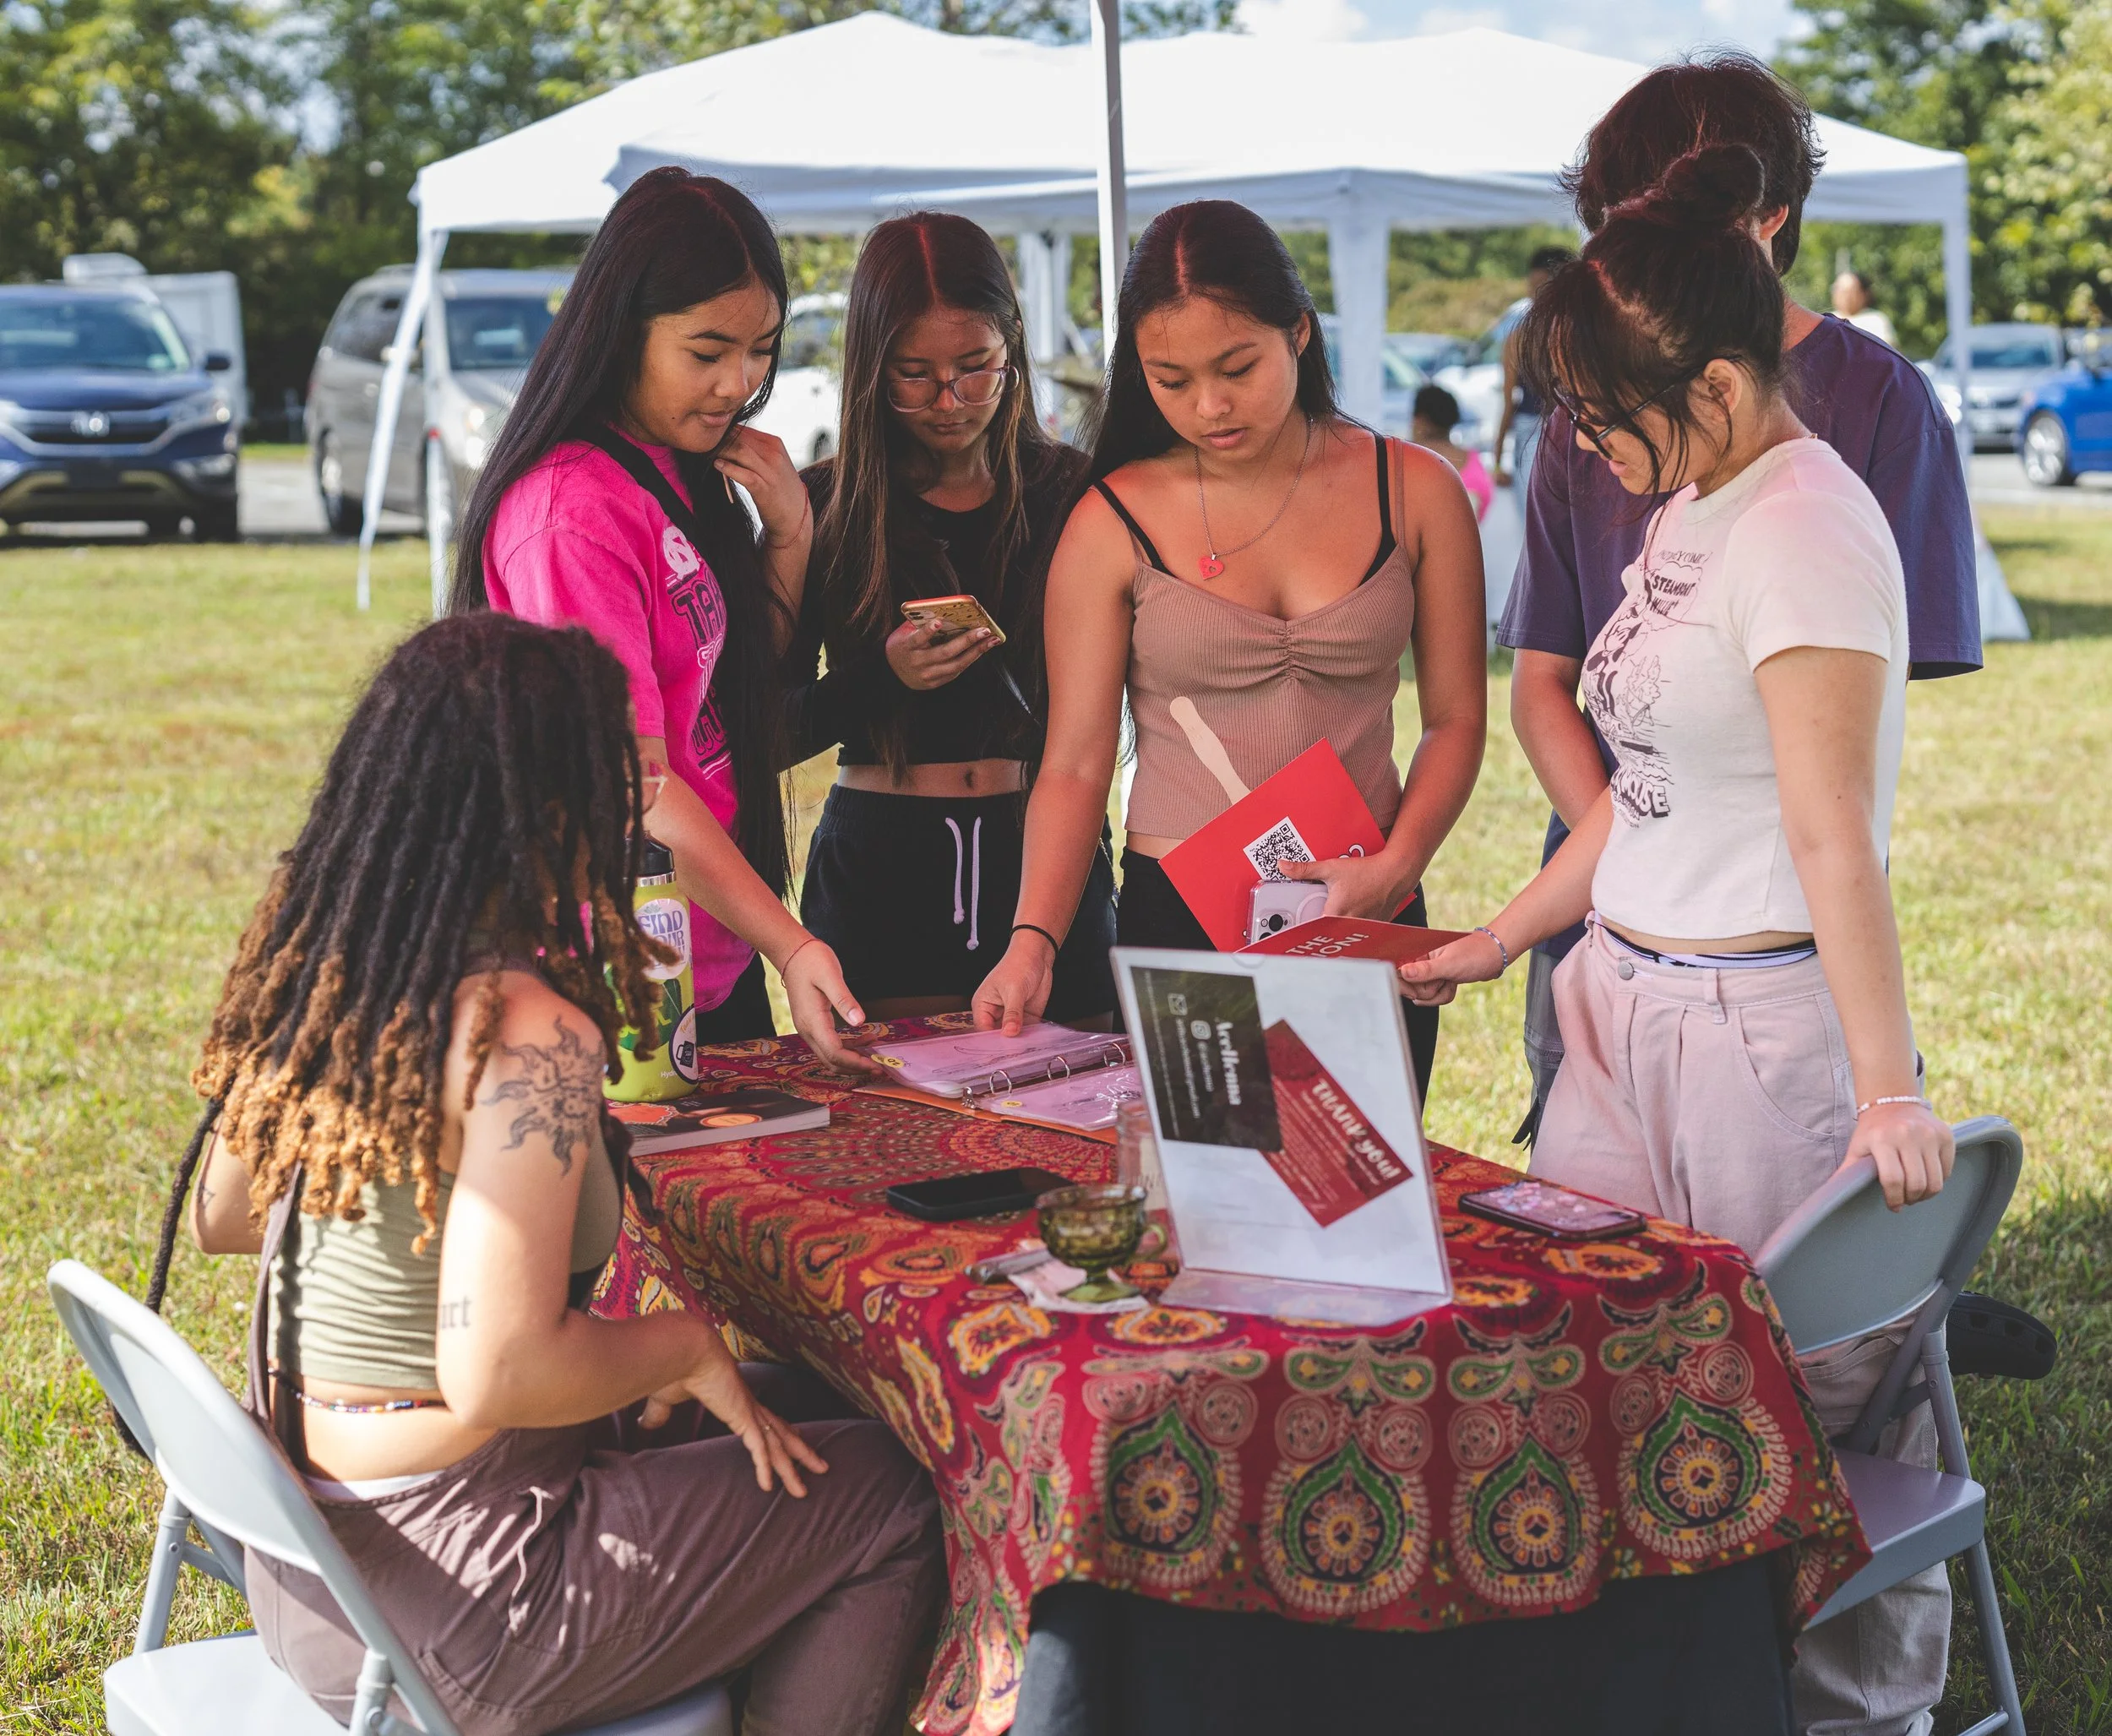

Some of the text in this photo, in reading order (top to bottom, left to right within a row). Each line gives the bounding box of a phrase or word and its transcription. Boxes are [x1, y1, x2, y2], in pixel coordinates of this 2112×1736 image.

[1285, 935, 1334, 955] THE
[1310, 933, 1369, 958] ION!
[661, 1069, 678, 1079] Hydr
